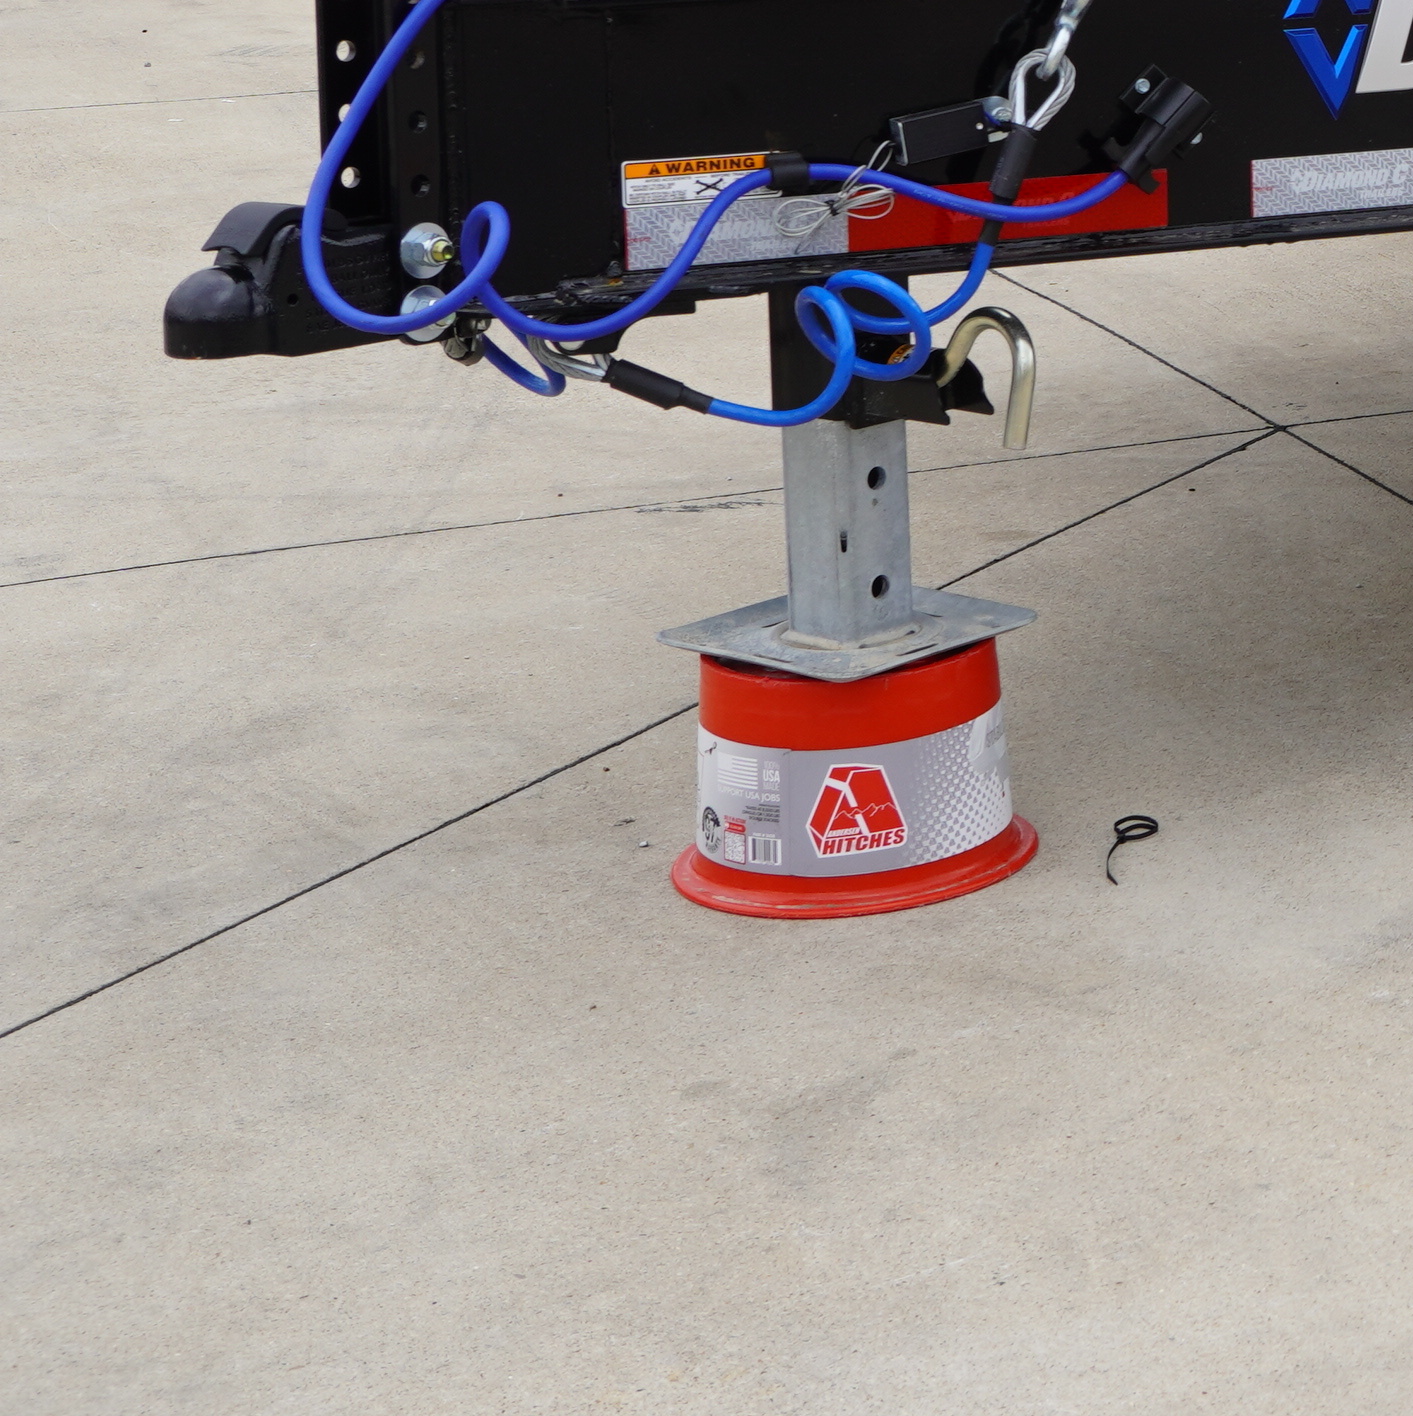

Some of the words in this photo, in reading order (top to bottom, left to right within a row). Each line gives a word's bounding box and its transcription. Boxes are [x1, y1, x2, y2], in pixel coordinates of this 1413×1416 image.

[665, 157, 755, 174] WARNING
[1301, 167, 1388, 192] DIAMOND
[762, 769, 780, 783] USA
[745, 790, 760, 801] USA
[760, 792, 781, 803] JOBS
[822, 828, 906, 855] HITCHES
